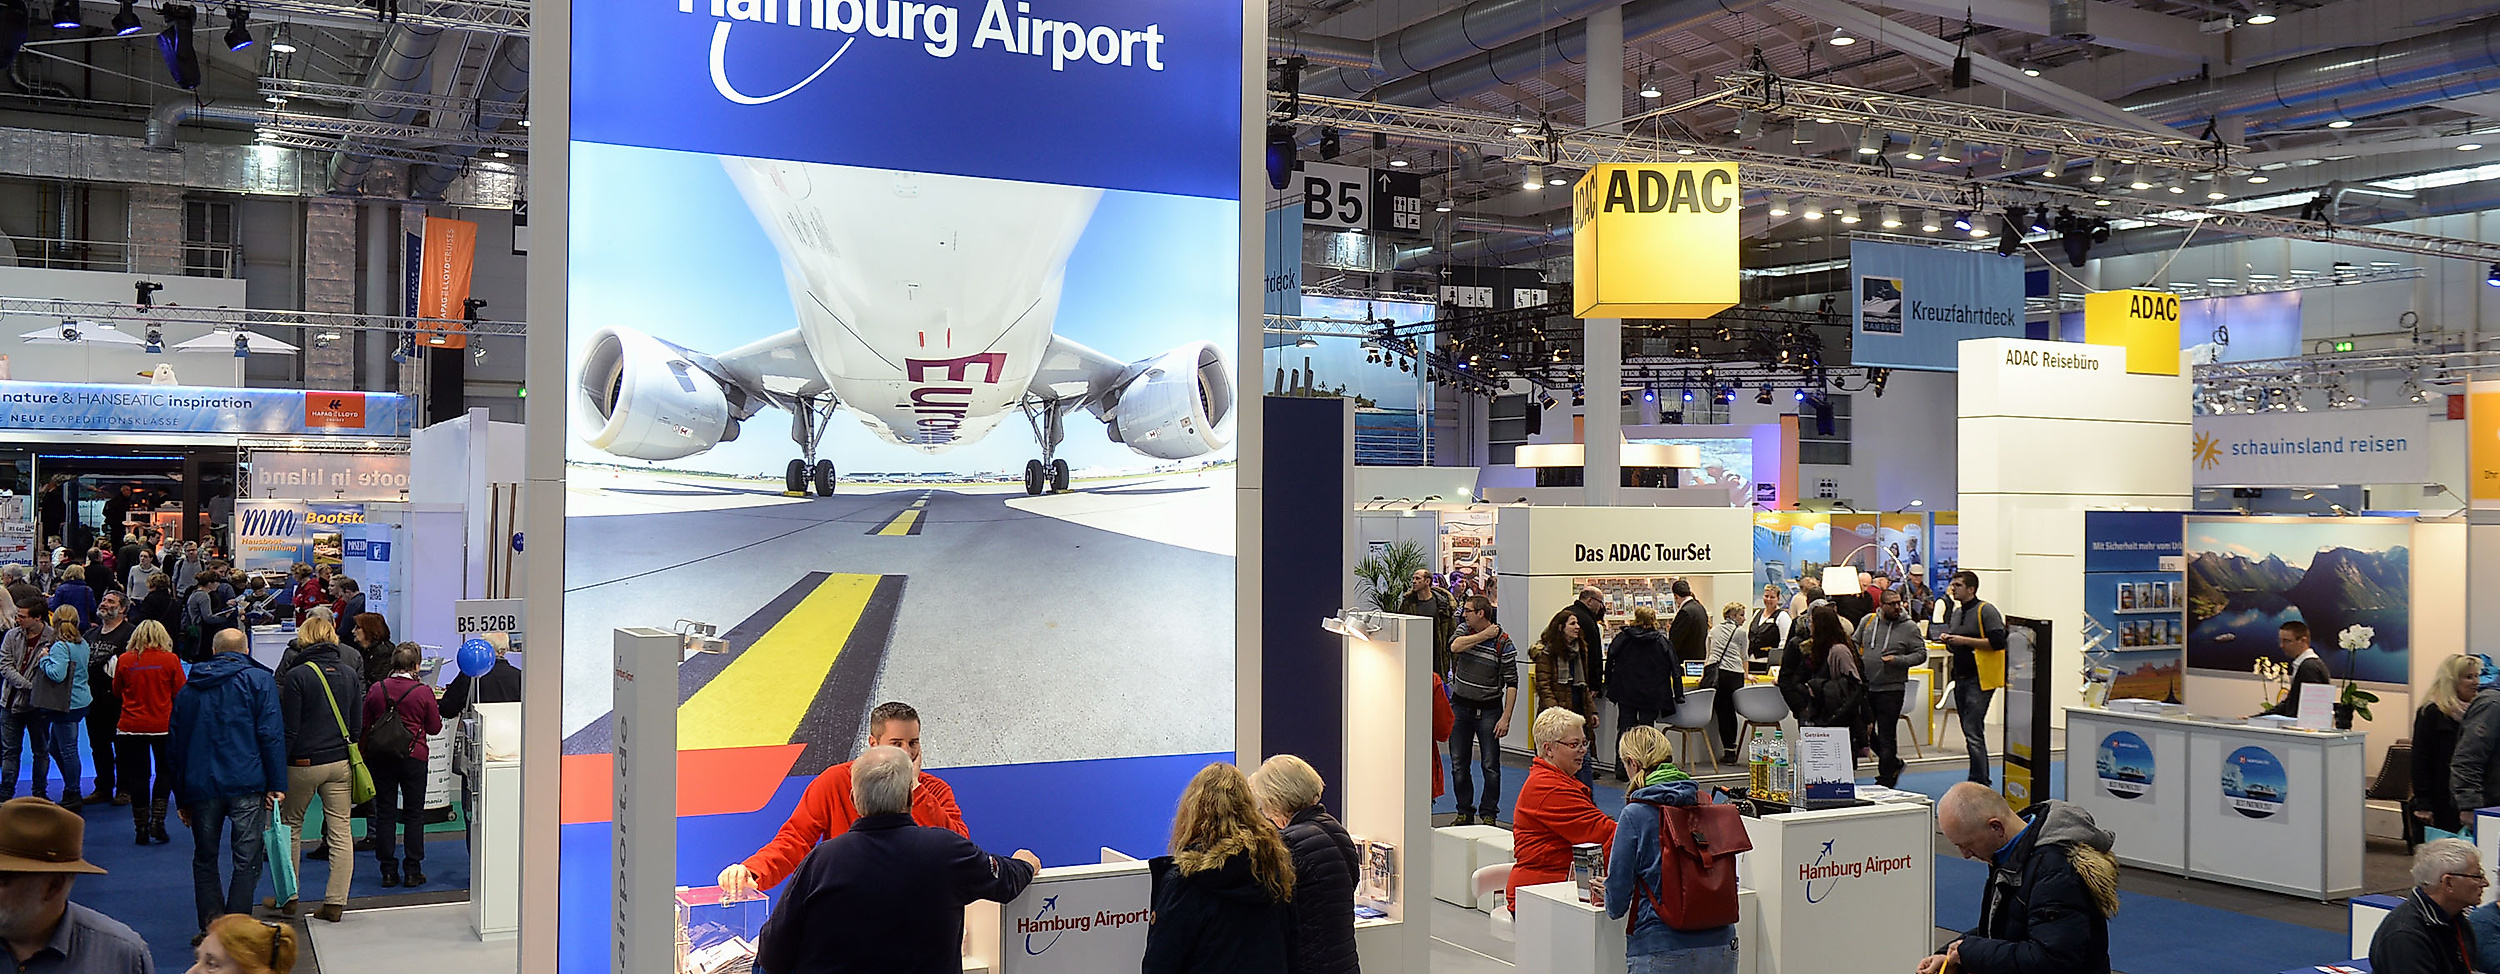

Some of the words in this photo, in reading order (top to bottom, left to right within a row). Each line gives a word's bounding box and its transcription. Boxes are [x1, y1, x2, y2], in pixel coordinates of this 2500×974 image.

[679, 0, 958, 58] amburg
[972, 0, 1165, 71] Airport
[1304, 177, 1363, 224] B5
[1574, 175, 1595, 233] ADAC
[1603, 168, 1732, 214] ADAC
[1912, 300, 2015, 326] Kreuzfahrtdeck
[2129, 295, 2177, 321] ADAC
[2006, 349, 2039, 367] ADAC
[2042, 351, 2099, 371] Reisebüro
[2, 392, 58, 404] nature
[62, 392, 74, 404] &
[78, 393, 164, 407] HANSEATIC
[168, 394, 253, 411] inspiration
[10, 414, 45, 423] NEUE
[51, 415, 179, 426] EXPEDITIONSKLASSE
[2232, 437, 2344, 456] schauinsland
[2350, 435, 2408, 452] reisen
[247, 544, 298, 552] vermittlung
[1575, 543, 1604, 562] Das
[1609, 543, 1650, 562] ADAC
[1655, 542, 1711, 561] TourSet
[458, 615, 516, 633] B5.526B
[1799, 860, 1862, 881] Hamburg
[1864, 854, 1912, 875] Airport
[1017, 915, 1091, 934] Hamburg
[1094, 908, 1149, 929] Airport
